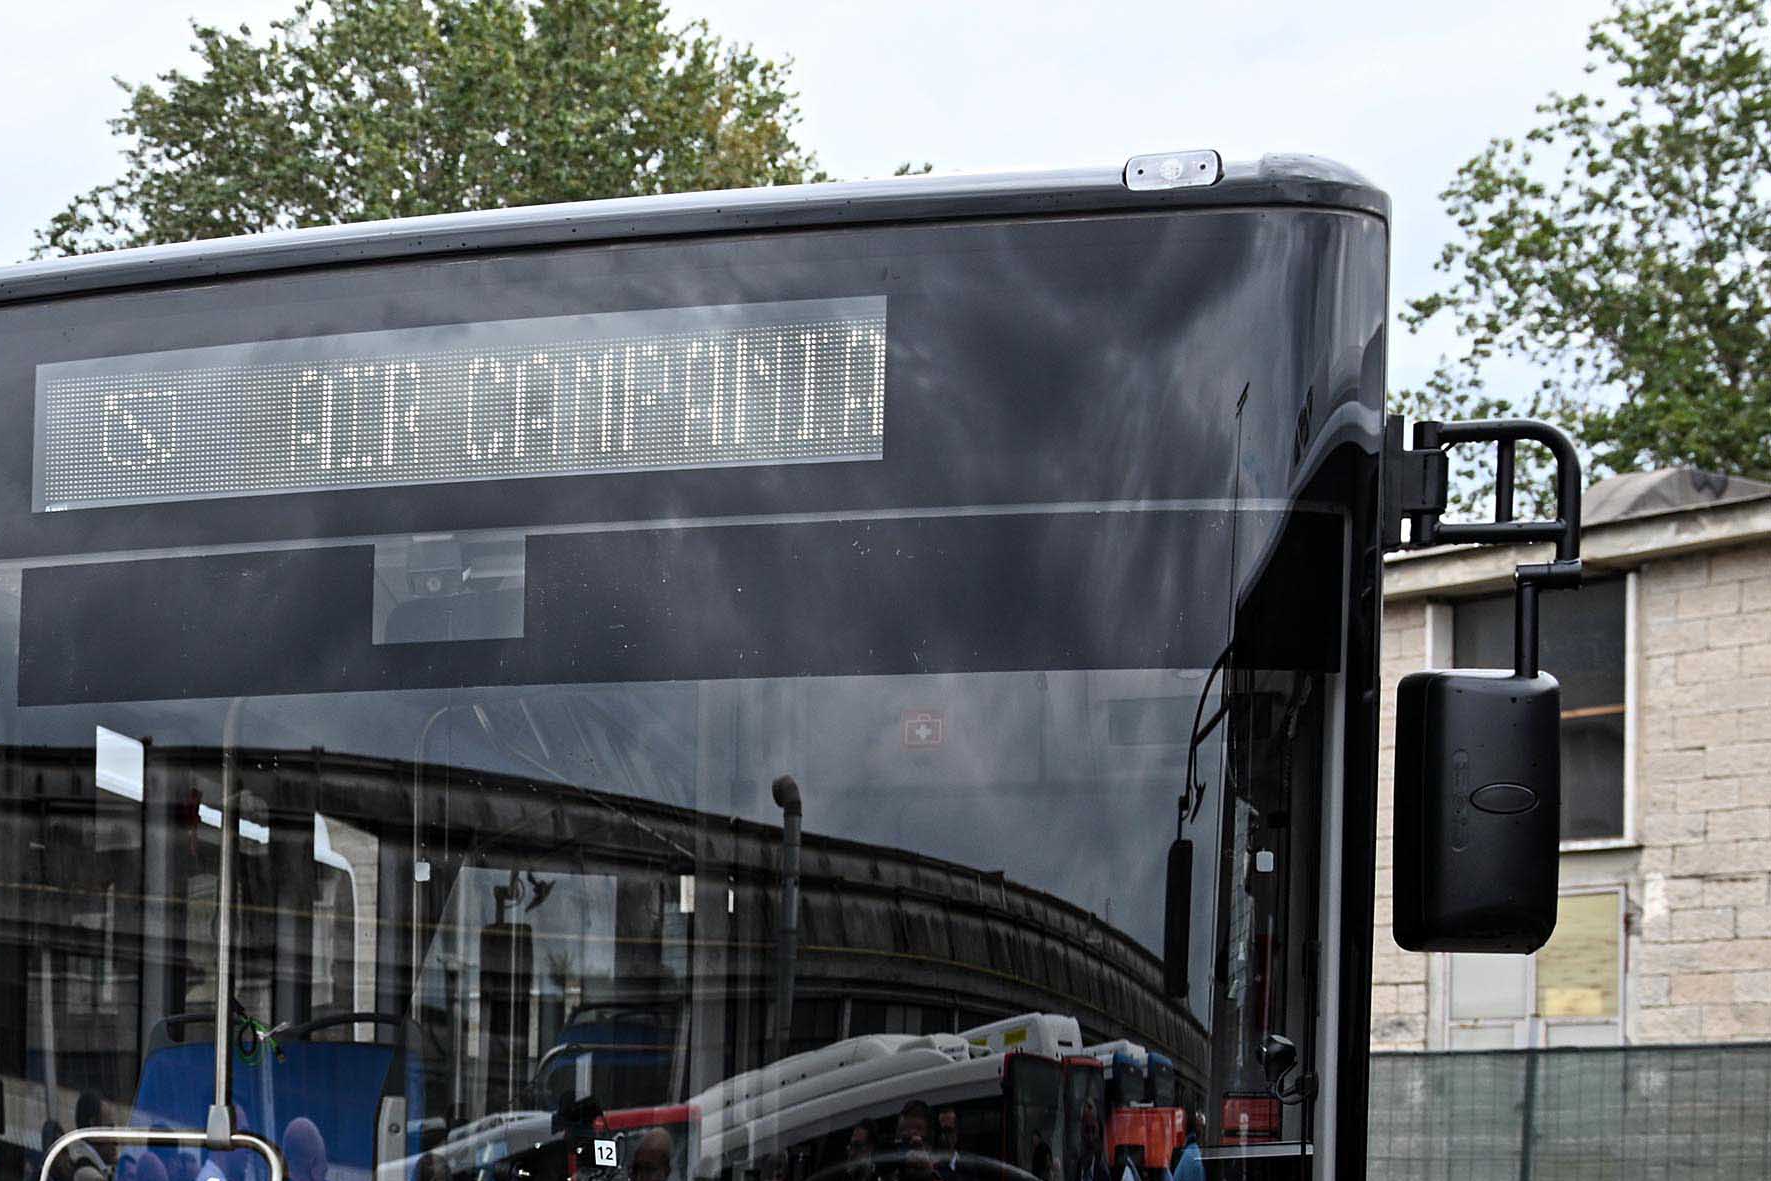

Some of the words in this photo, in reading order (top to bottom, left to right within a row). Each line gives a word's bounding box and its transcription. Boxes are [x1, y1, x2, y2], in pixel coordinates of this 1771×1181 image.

[289, 361, 421, 471] AIR
[466, 327, 885, 462] CAMPANIA
[597, 1145, 614, 1161] 12
